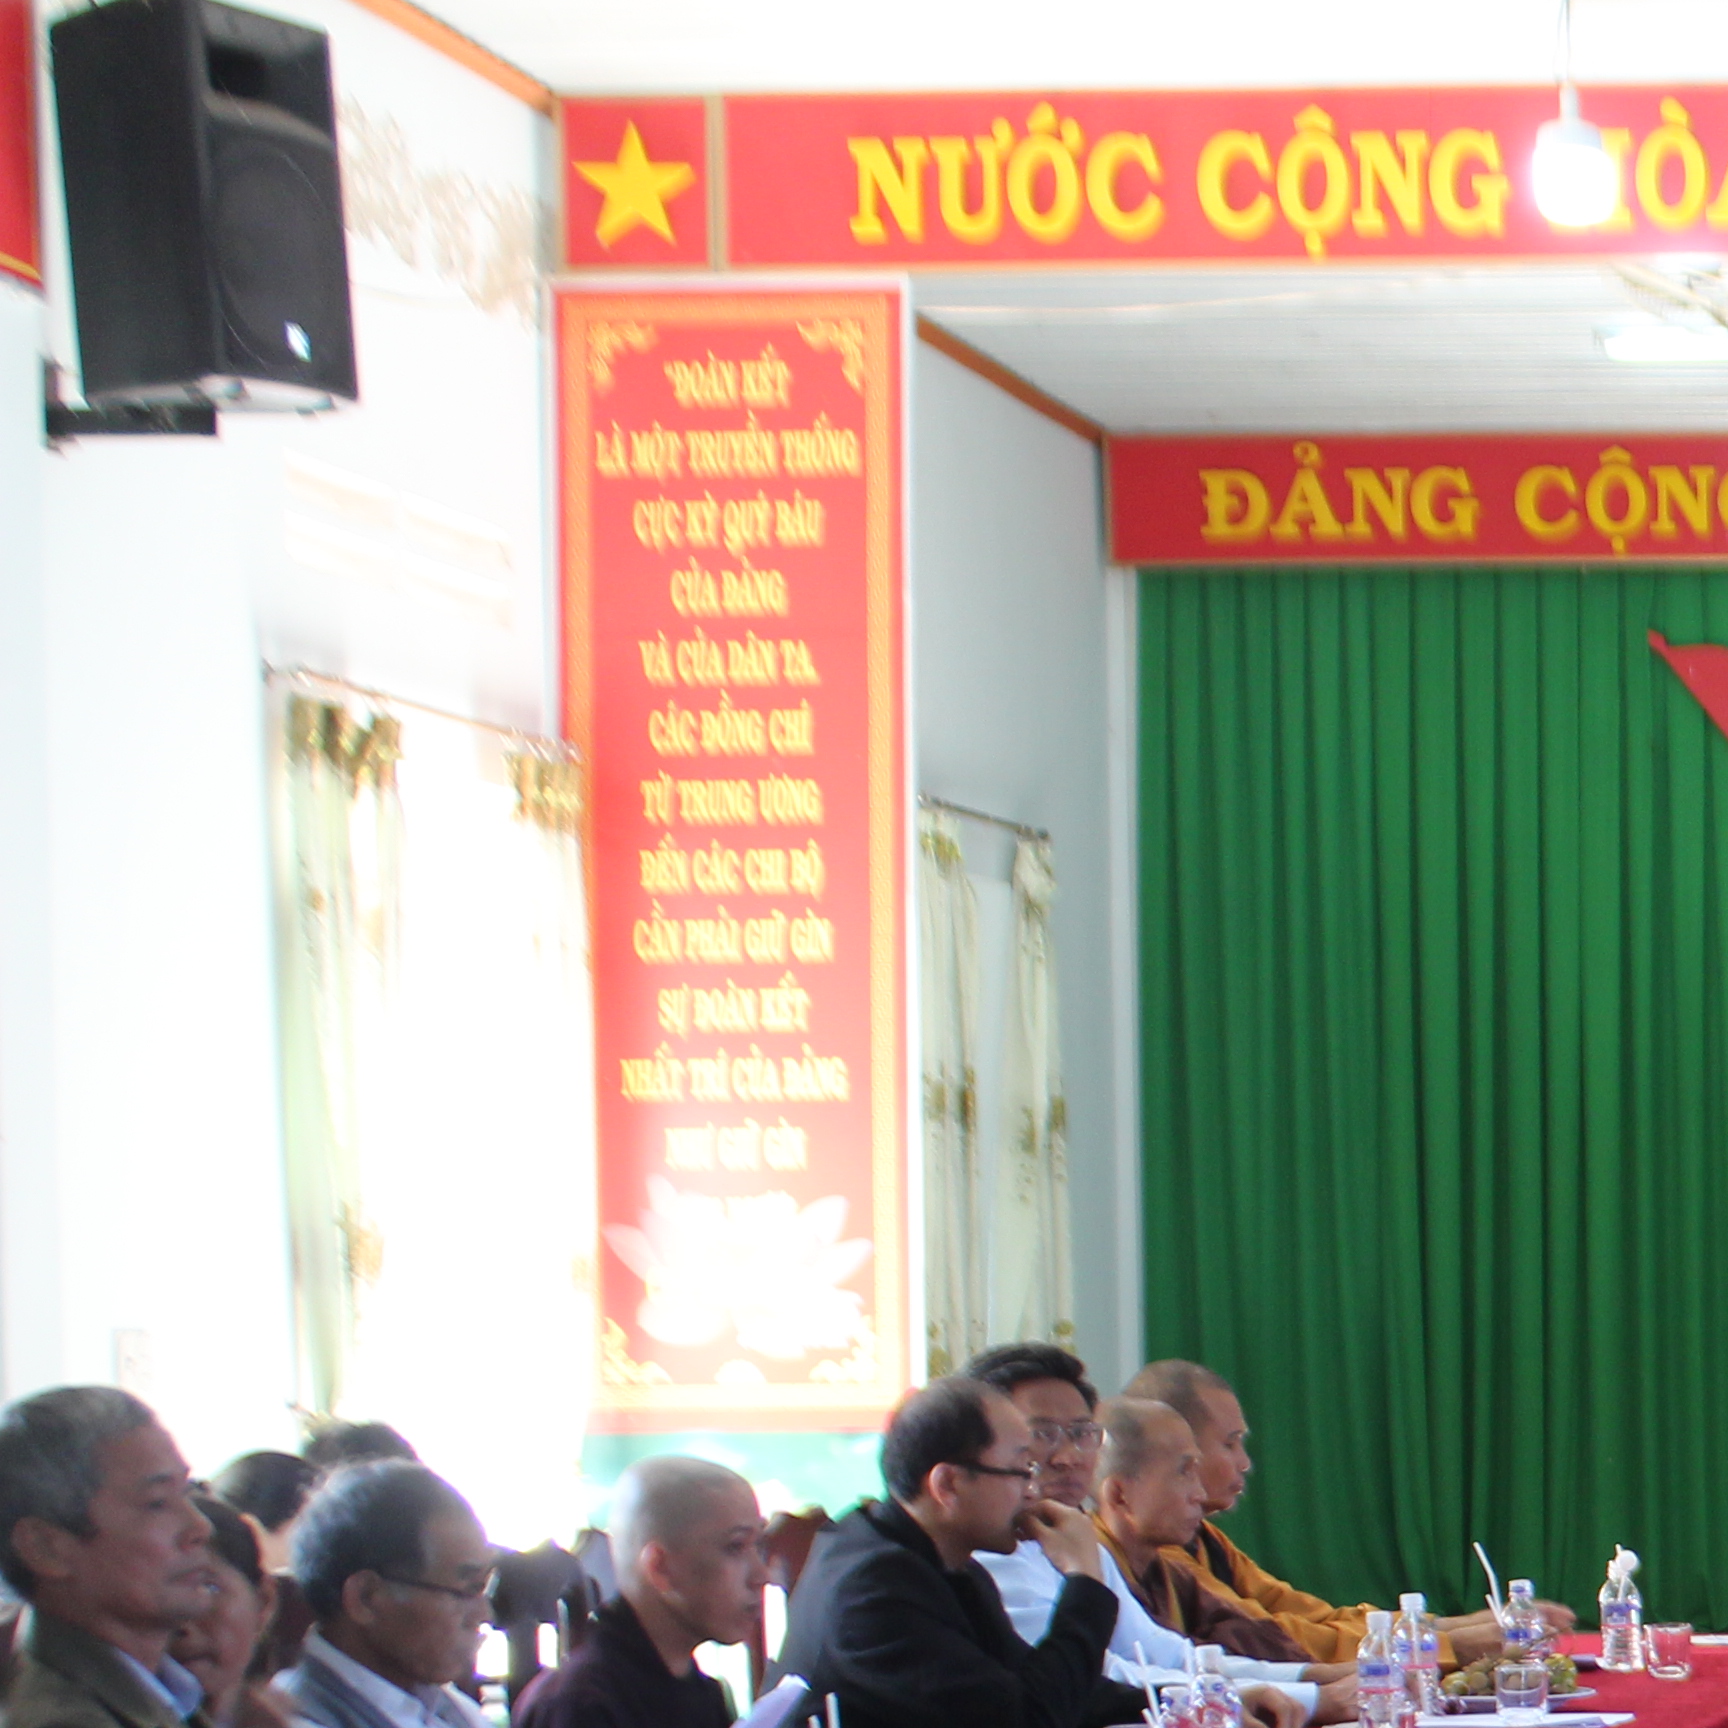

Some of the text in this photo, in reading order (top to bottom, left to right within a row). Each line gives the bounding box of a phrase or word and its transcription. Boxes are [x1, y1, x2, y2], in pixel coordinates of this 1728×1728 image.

[846, 100, 1166, 246] NƯỚC
[1196, 103, 1513, 262] CỘNG
[1199, 441, 1478, 542] ĐẢNG
